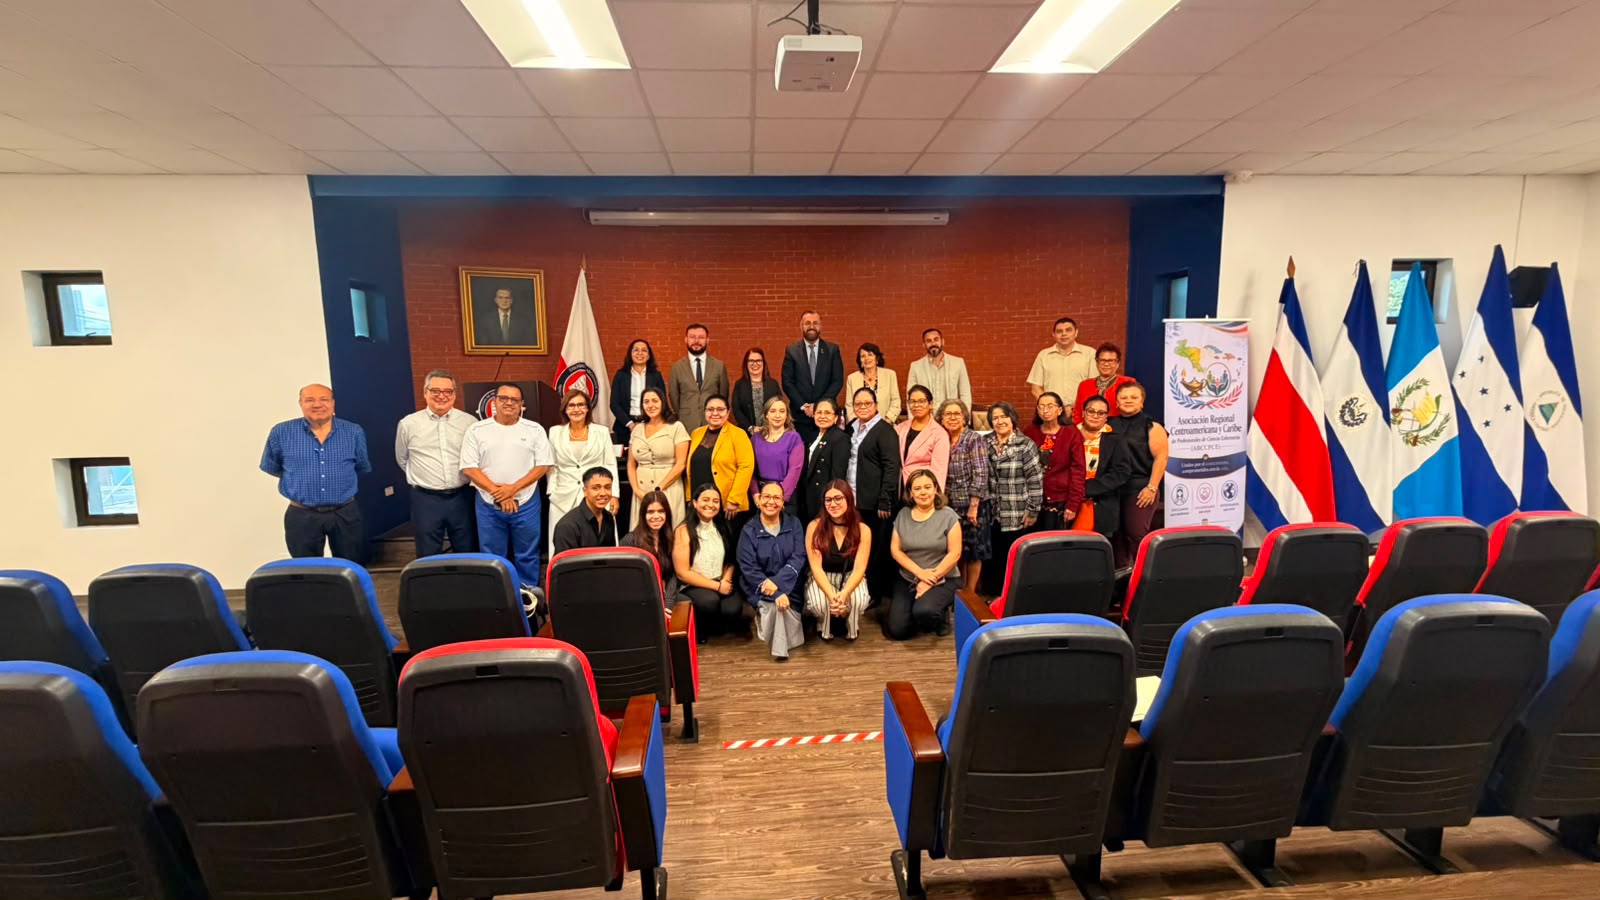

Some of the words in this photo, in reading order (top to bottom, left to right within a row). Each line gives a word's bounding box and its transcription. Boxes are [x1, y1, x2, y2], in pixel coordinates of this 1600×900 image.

[1210, 414, 1235, 424] Regional
[1171, 427, 1217, 435] Centroamericana
[1218, 427, 1222, 435] y
[1223, 424, 1242, 432] Caribe
